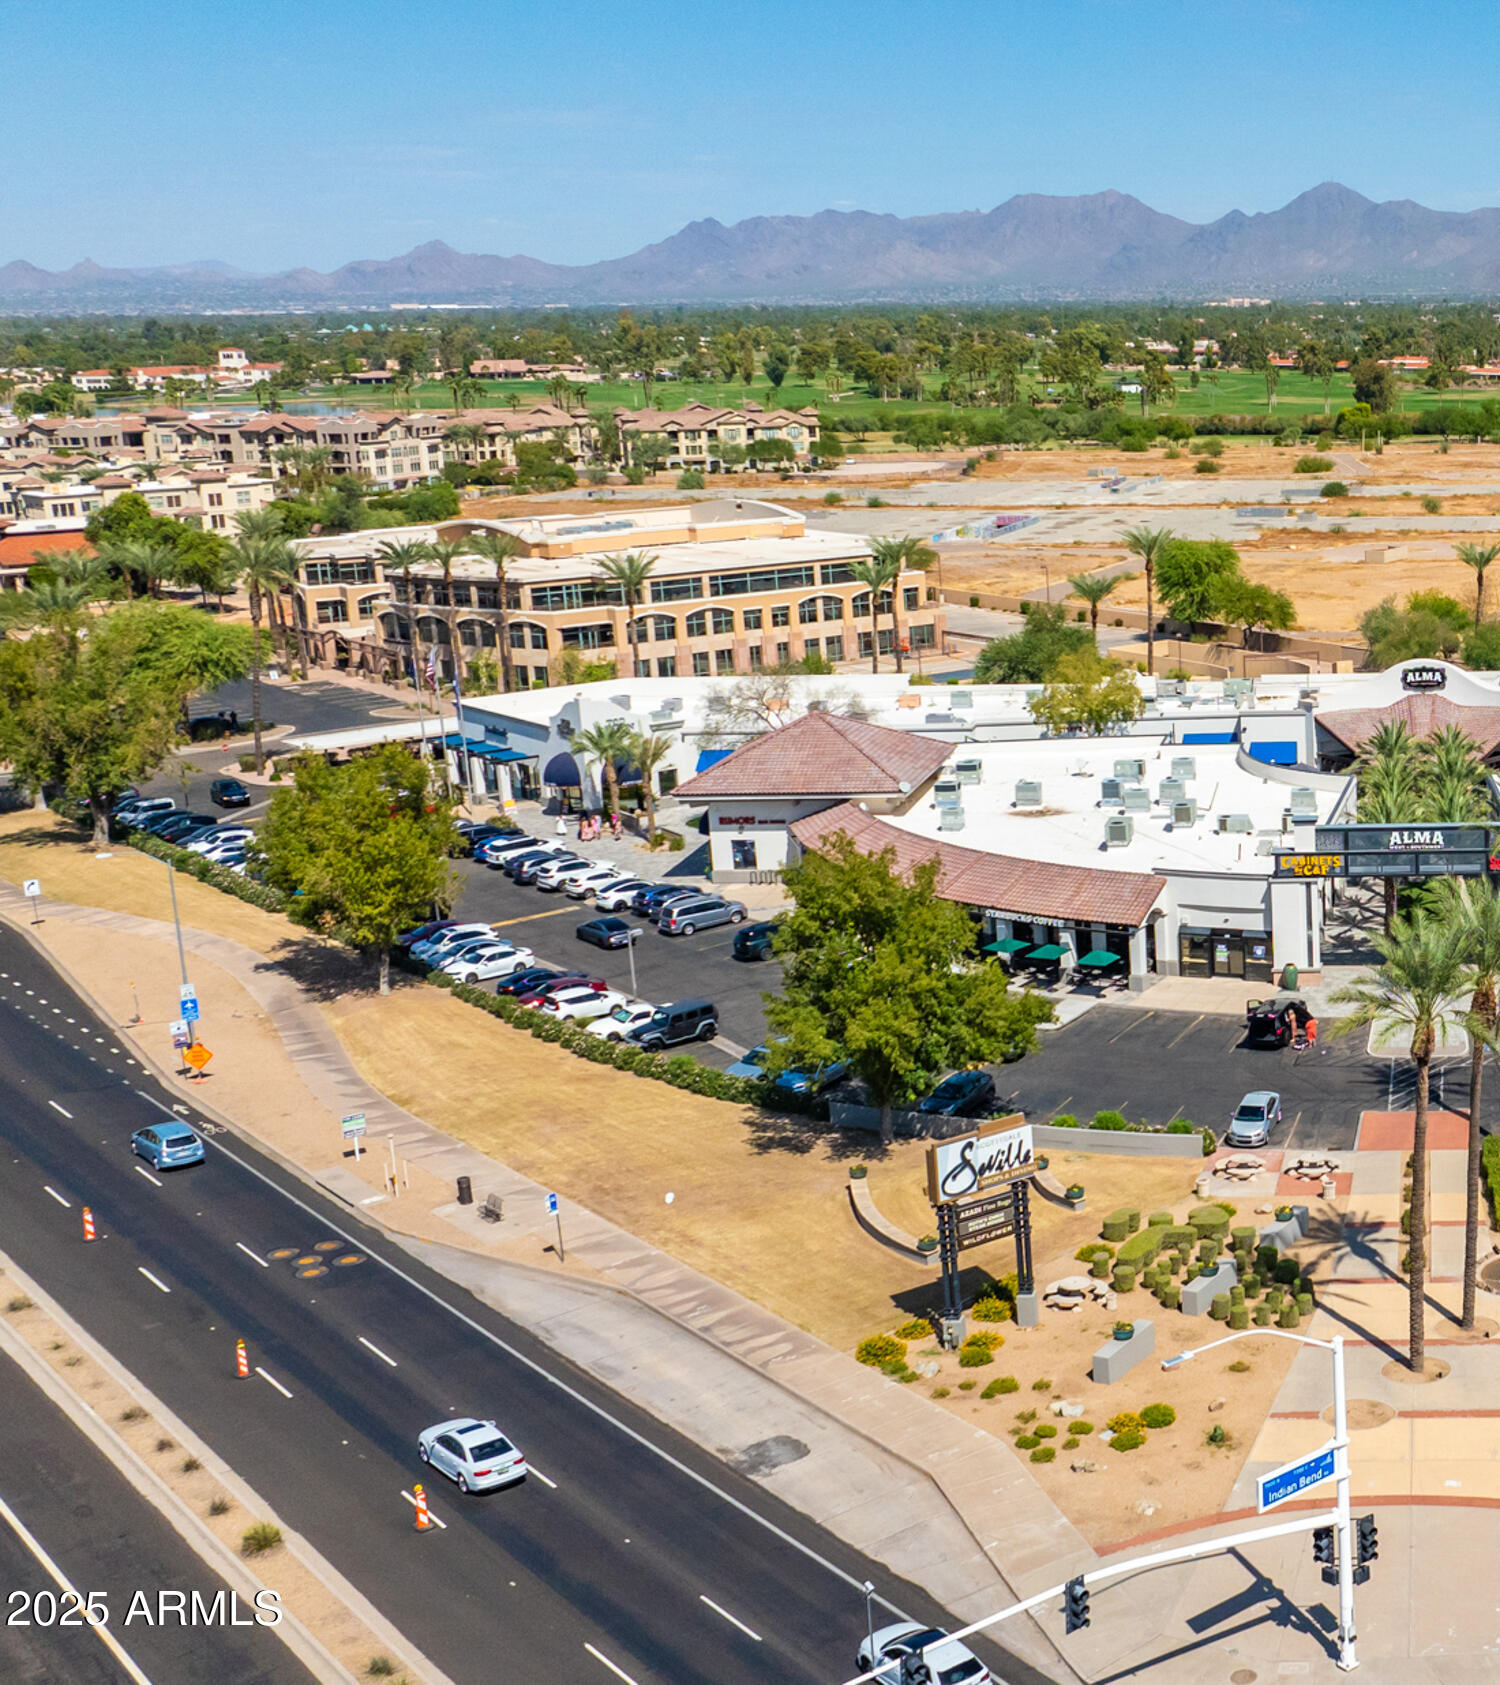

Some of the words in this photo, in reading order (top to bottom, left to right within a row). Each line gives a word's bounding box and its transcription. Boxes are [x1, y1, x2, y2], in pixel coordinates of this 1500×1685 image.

[1407, 671, 1442, 682] ALMA
[1389, 831, 1444, 846] ALMA
[1281, 855, 1342, 869] CABINETS
[1268, 1482, 1298, 1503] Indian
[1299, 1468, 1322, 1488] Bend
